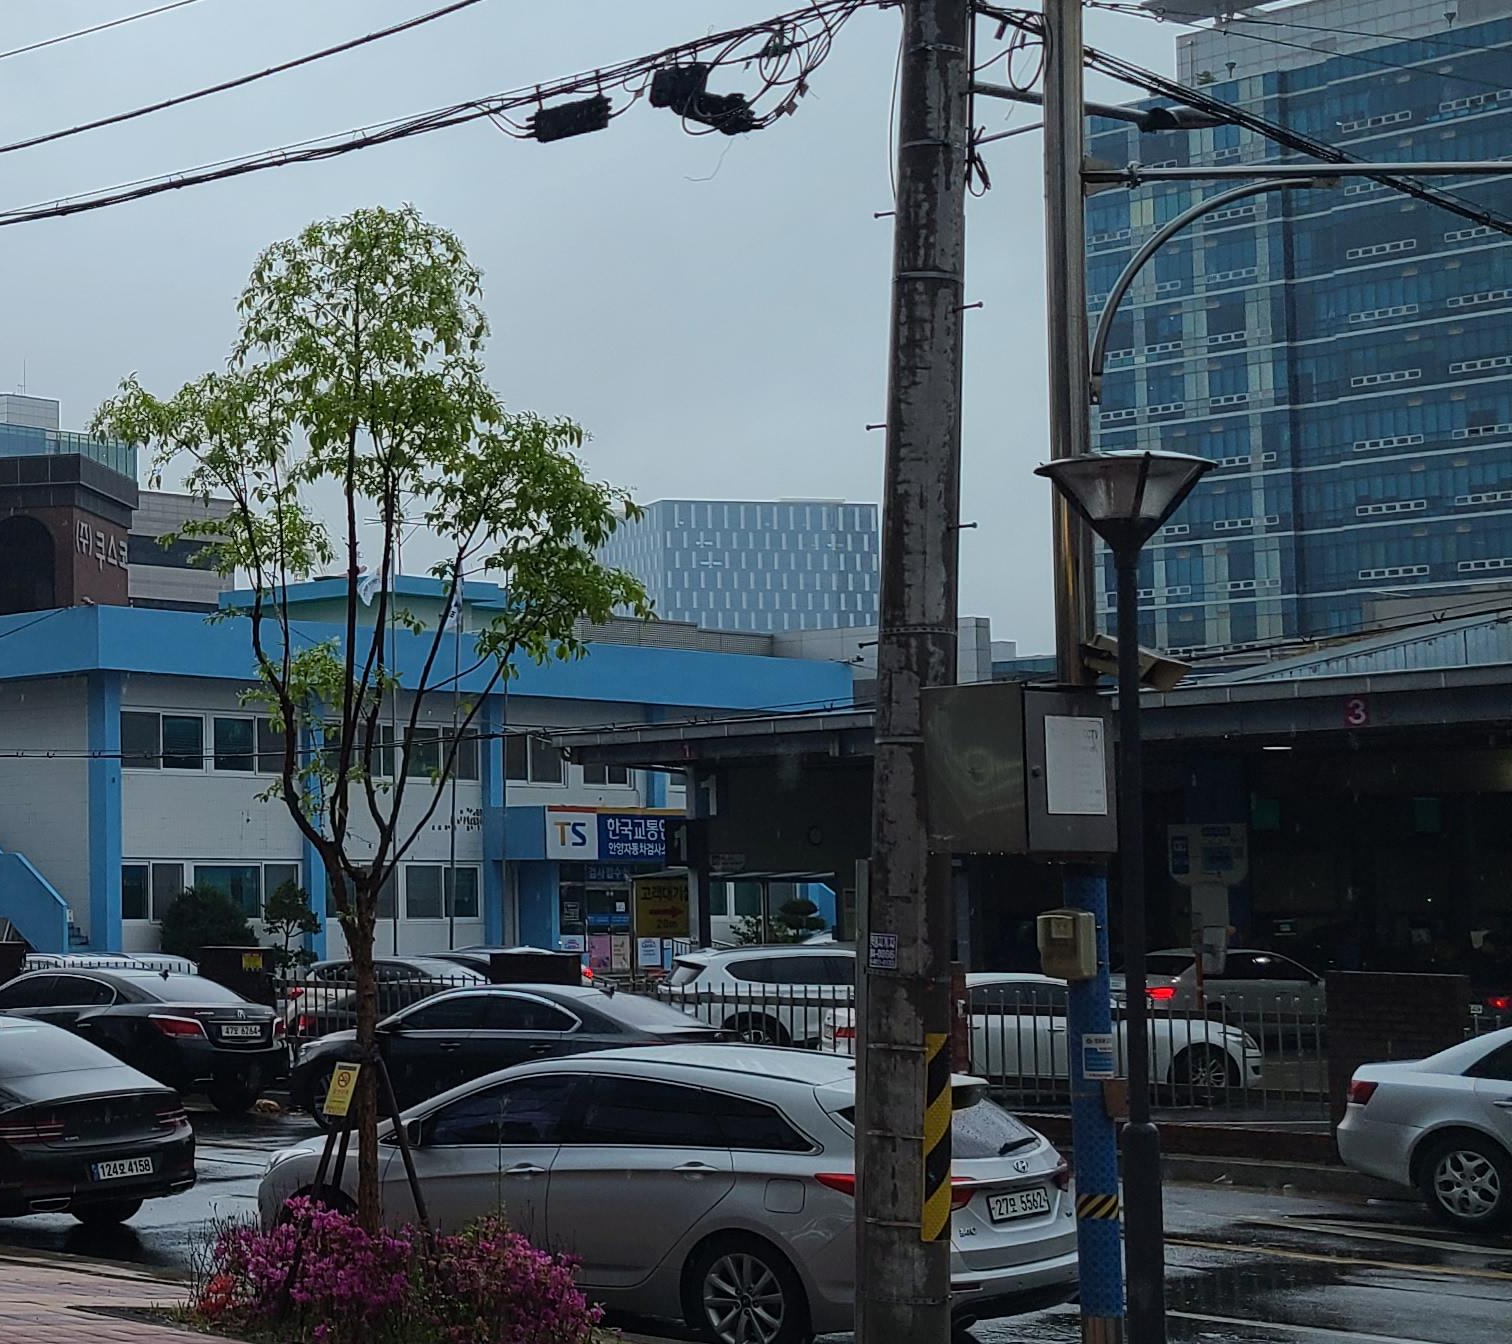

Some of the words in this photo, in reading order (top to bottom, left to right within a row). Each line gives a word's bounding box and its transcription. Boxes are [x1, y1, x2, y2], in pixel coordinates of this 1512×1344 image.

[76, 519, 129, 571] (주)쿠스코
[1348, 699, 1366, 724] 3
[700, 774, 717, 816] 1
[554, 821, 587, 846] TS
[656, 919, 678, 929] 20m
[128, 1158, 151, 1173] 4158
[996, 1197, 1018, 1216] 27모
[1020, 1191, 1045, 1211] 5562
